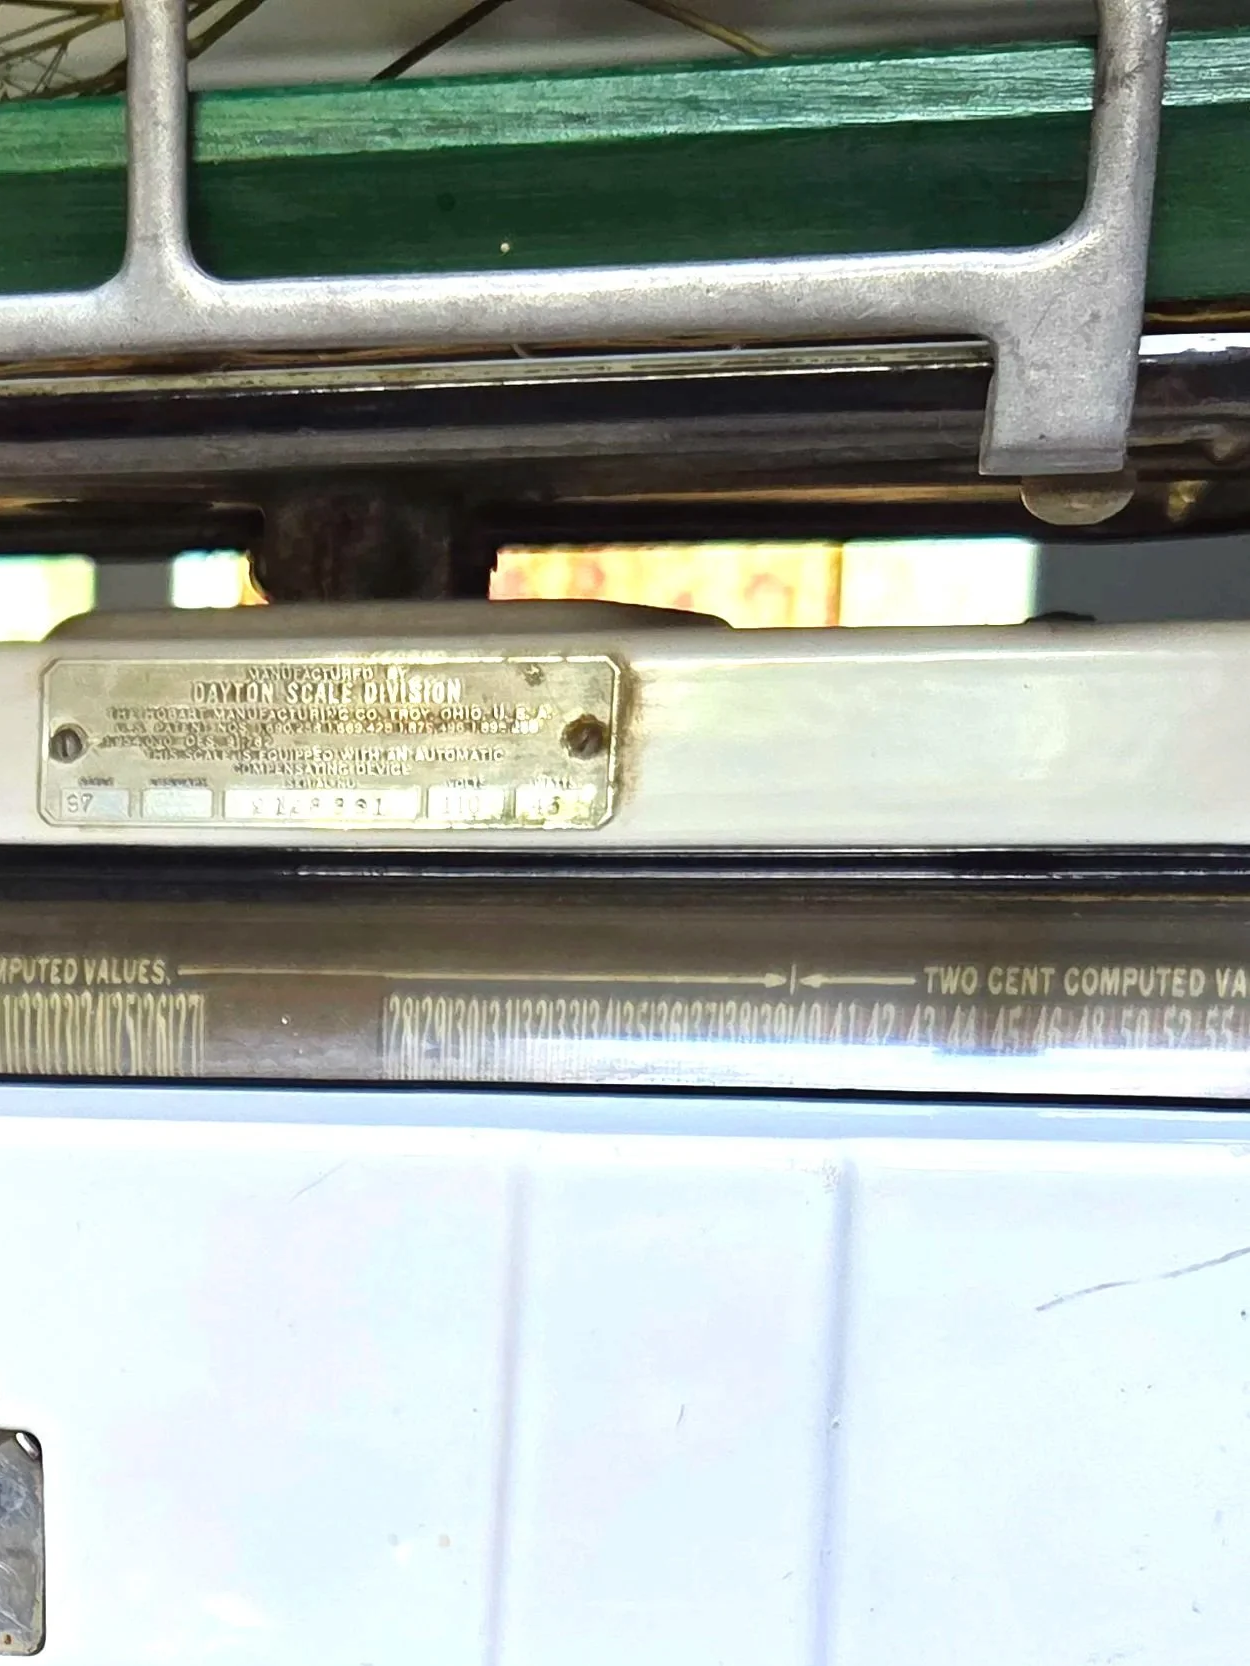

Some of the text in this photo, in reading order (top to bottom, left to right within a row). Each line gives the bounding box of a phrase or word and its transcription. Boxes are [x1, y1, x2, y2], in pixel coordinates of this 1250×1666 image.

[248, 667, 374, 682] MANUFACTURED
[192, 679, 462, 704] DAYTON SCALE DIVISION
[213, 707, 349, 722] MANUFACTURING
[257, 748, 334, 762] EQUIPPED
[340, 748, 380, 762] WITH
[387, 748, 408, 762] AN
[415, 748, 505, 762] AUTOMATIC
[232, 761, 412, 776] COMPENSATING DEVICE
[922, 965, 979, 996] TWO
[987, 966, 1056, 997] CENT
[1063, 966, 1206, 998] COMPUTED
